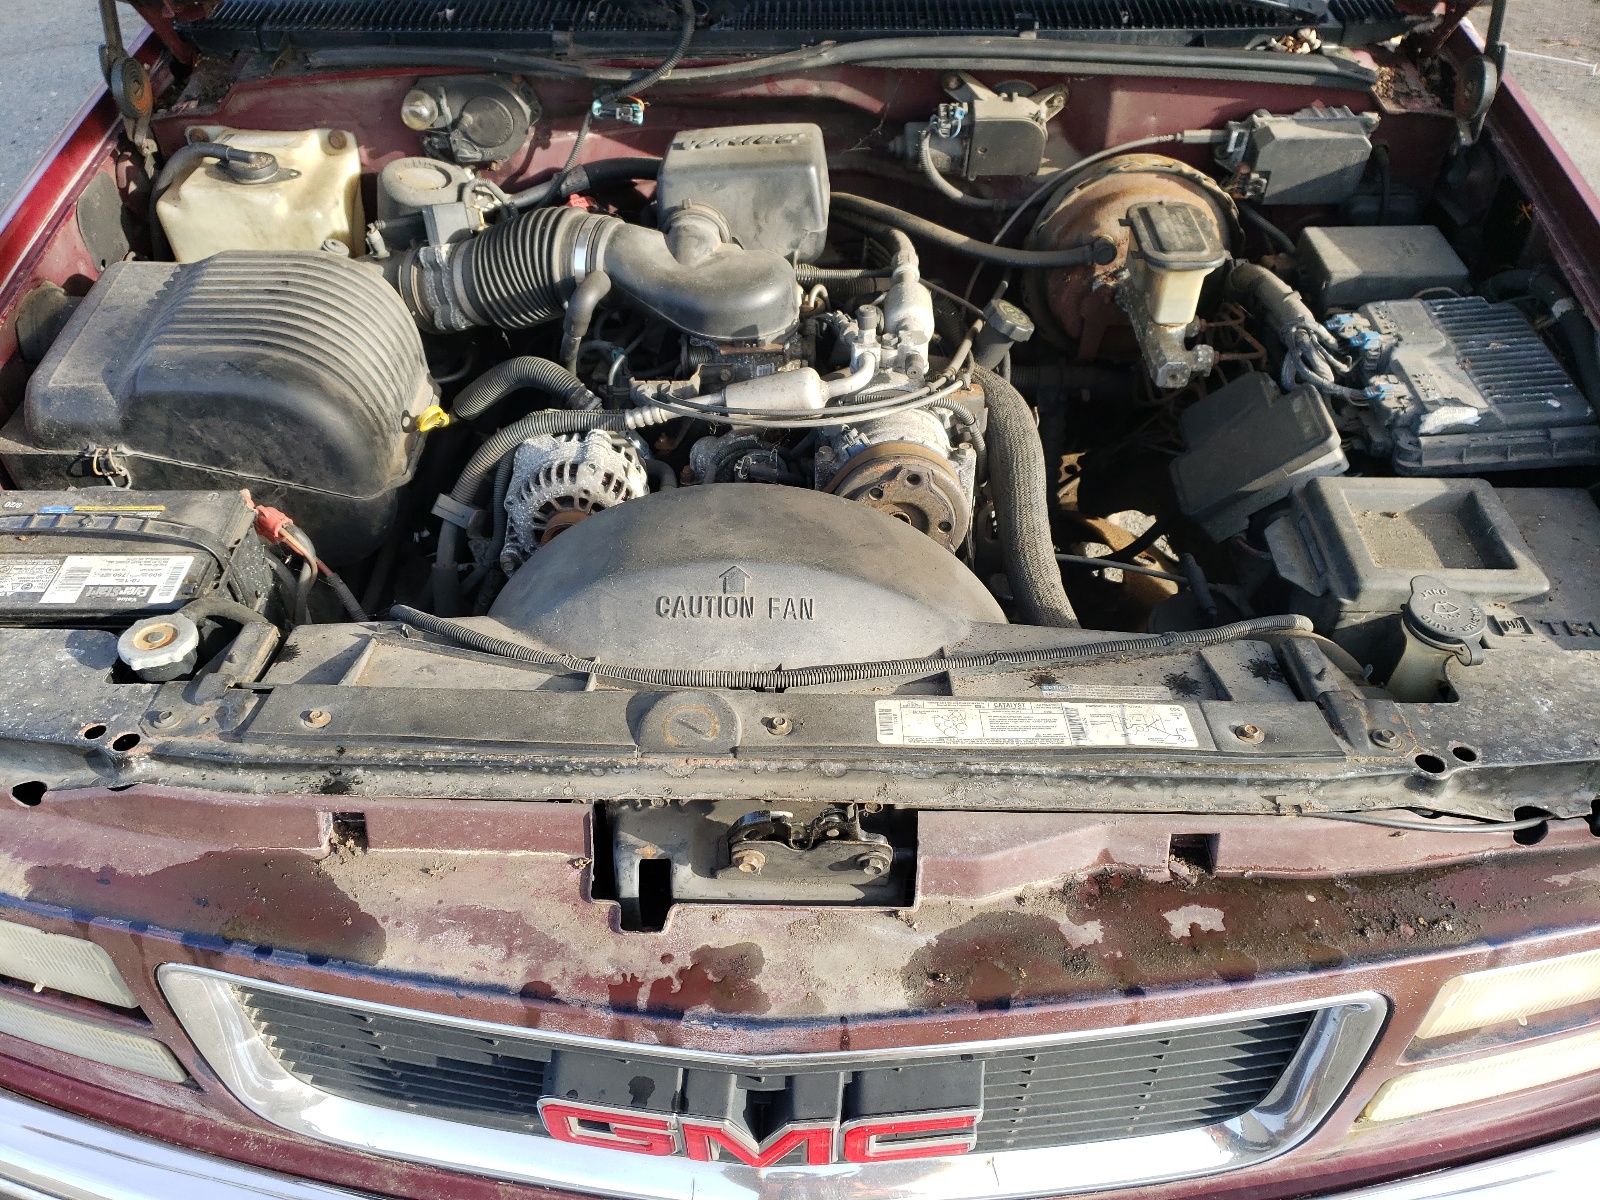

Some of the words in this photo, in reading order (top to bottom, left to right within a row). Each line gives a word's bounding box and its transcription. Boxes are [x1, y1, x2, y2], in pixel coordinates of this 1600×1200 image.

[85, 586, 151, 598] EverStart
[1420, 588, 1448, 600] ONLY
[655, 595, 755, 619] CAUTION
[768, 597, 814, 620] FAN
[1420, 614, 1456, 632] FLUID
[1459, 606, 1481, 632] WASHER
[536, 1094, 984, 1168] GMC
